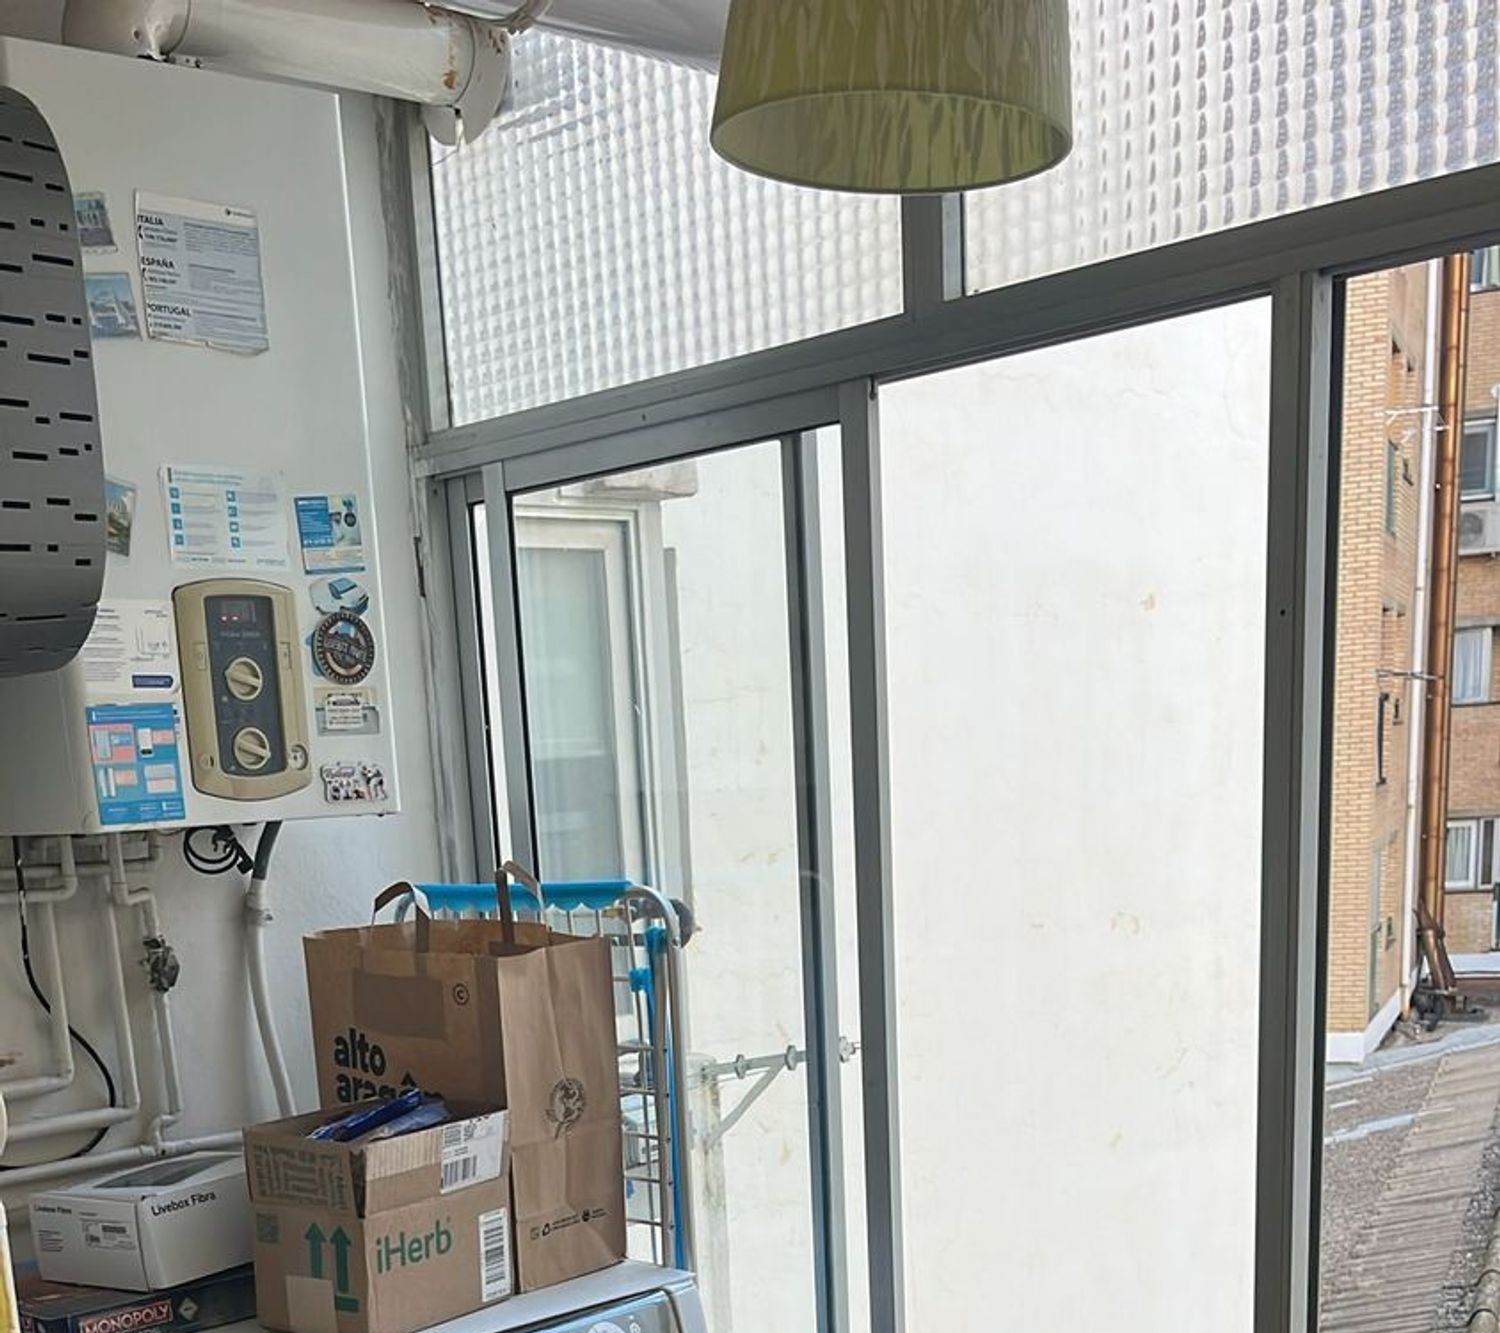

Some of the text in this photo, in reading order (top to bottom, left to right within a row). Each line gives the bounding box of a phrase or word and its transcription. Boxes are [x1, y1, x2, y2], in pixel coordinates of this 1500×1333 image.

[137, 215, 164, 226] ITALIA
[334, 1027, 386, 1076] alto
[336, 1072, 445, 1103] ara
[151, 1191, 216, 1216] Livebox Fibra
[376, 1219, 452, 1274] iHerb
